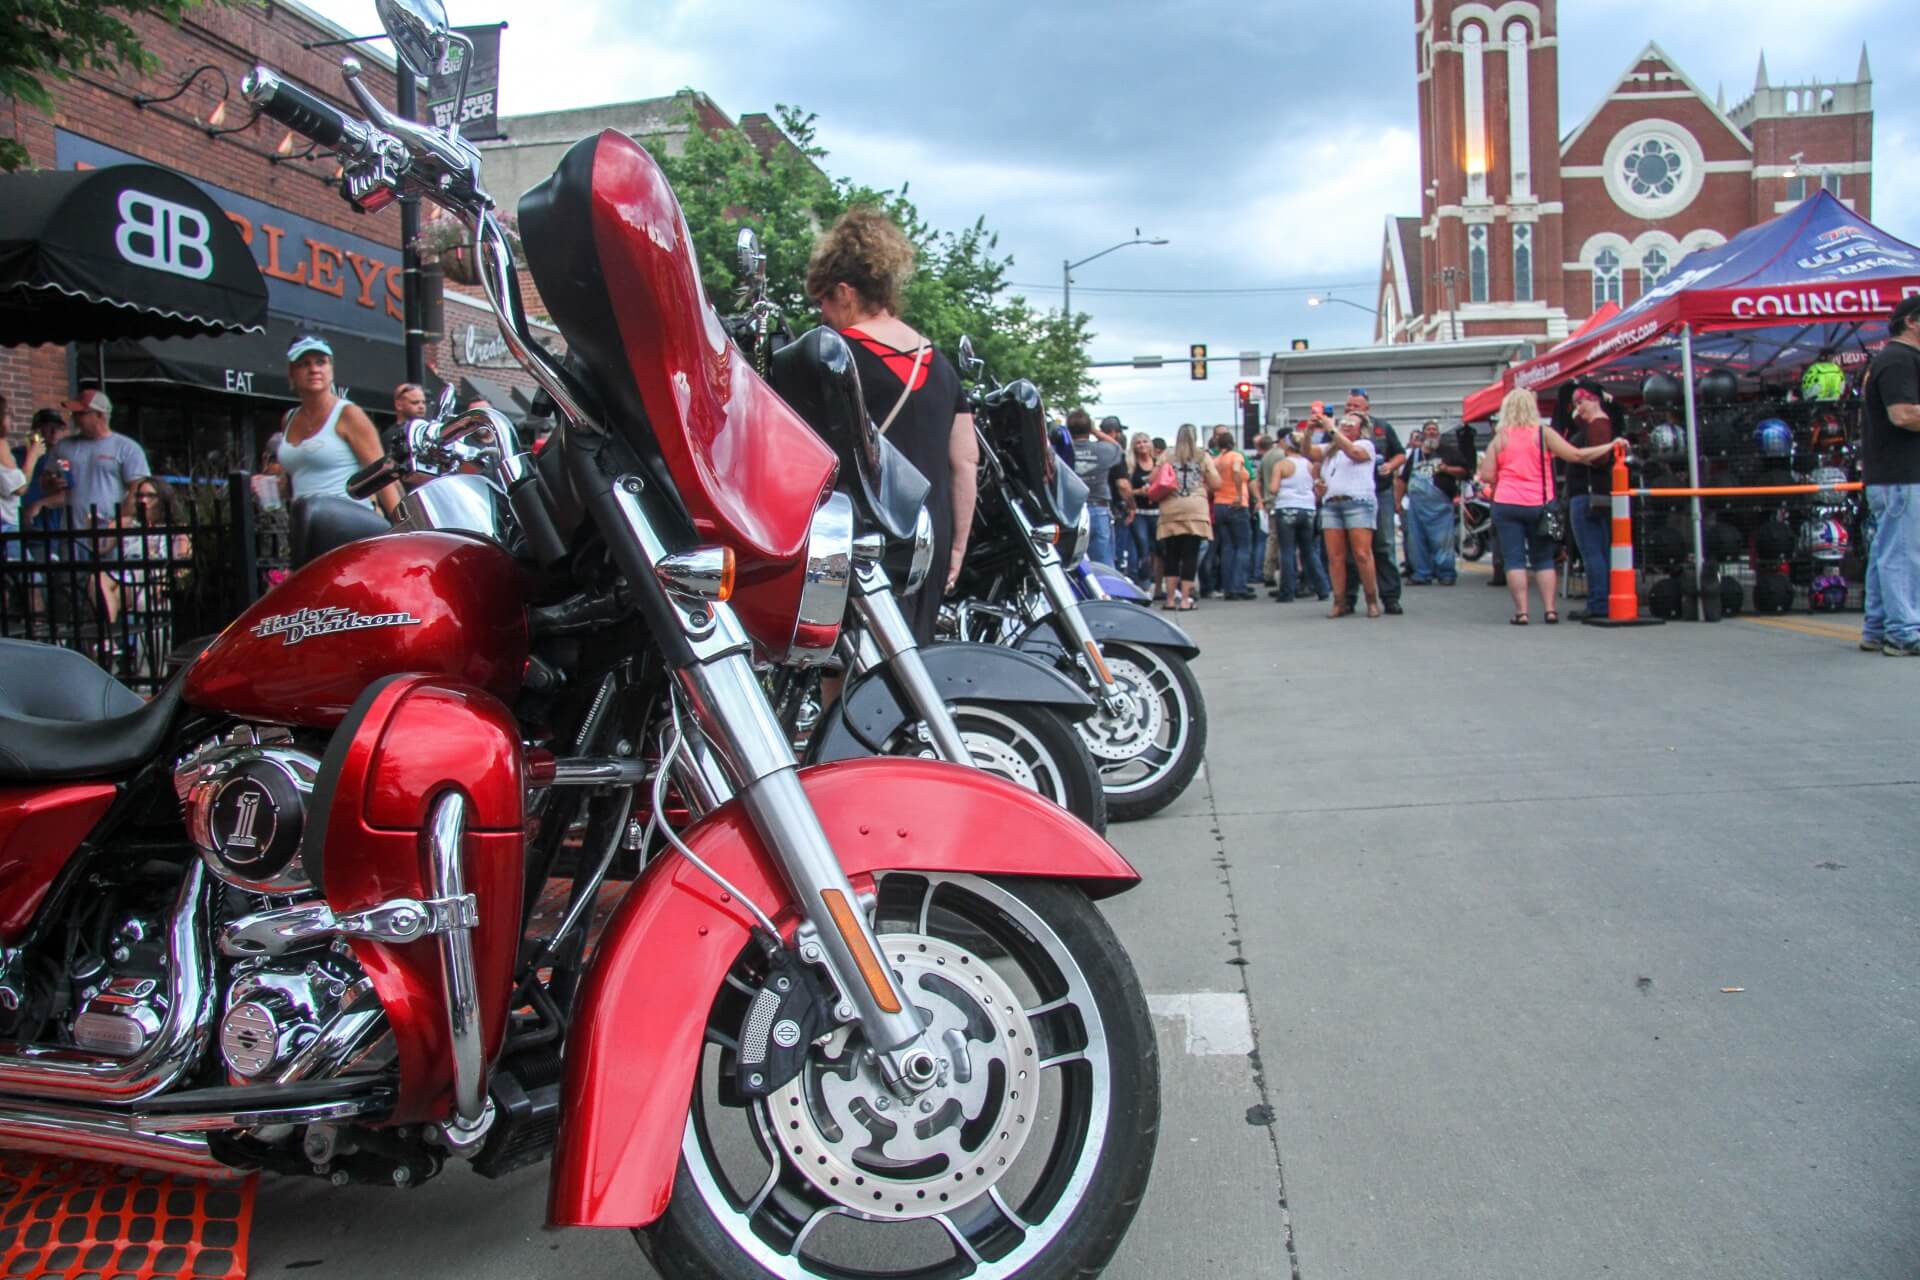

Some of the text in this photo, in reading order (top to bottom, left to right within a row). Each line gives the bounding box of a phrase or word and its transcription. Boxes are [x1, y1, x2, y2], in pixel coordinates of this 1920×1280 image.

[1731, 288, 1893, 319] COUNCIL
[225, 369, 255, 393] EAT
[250, 606, 350, 638] Harley
[282, 611, 423, 646] Davidson
